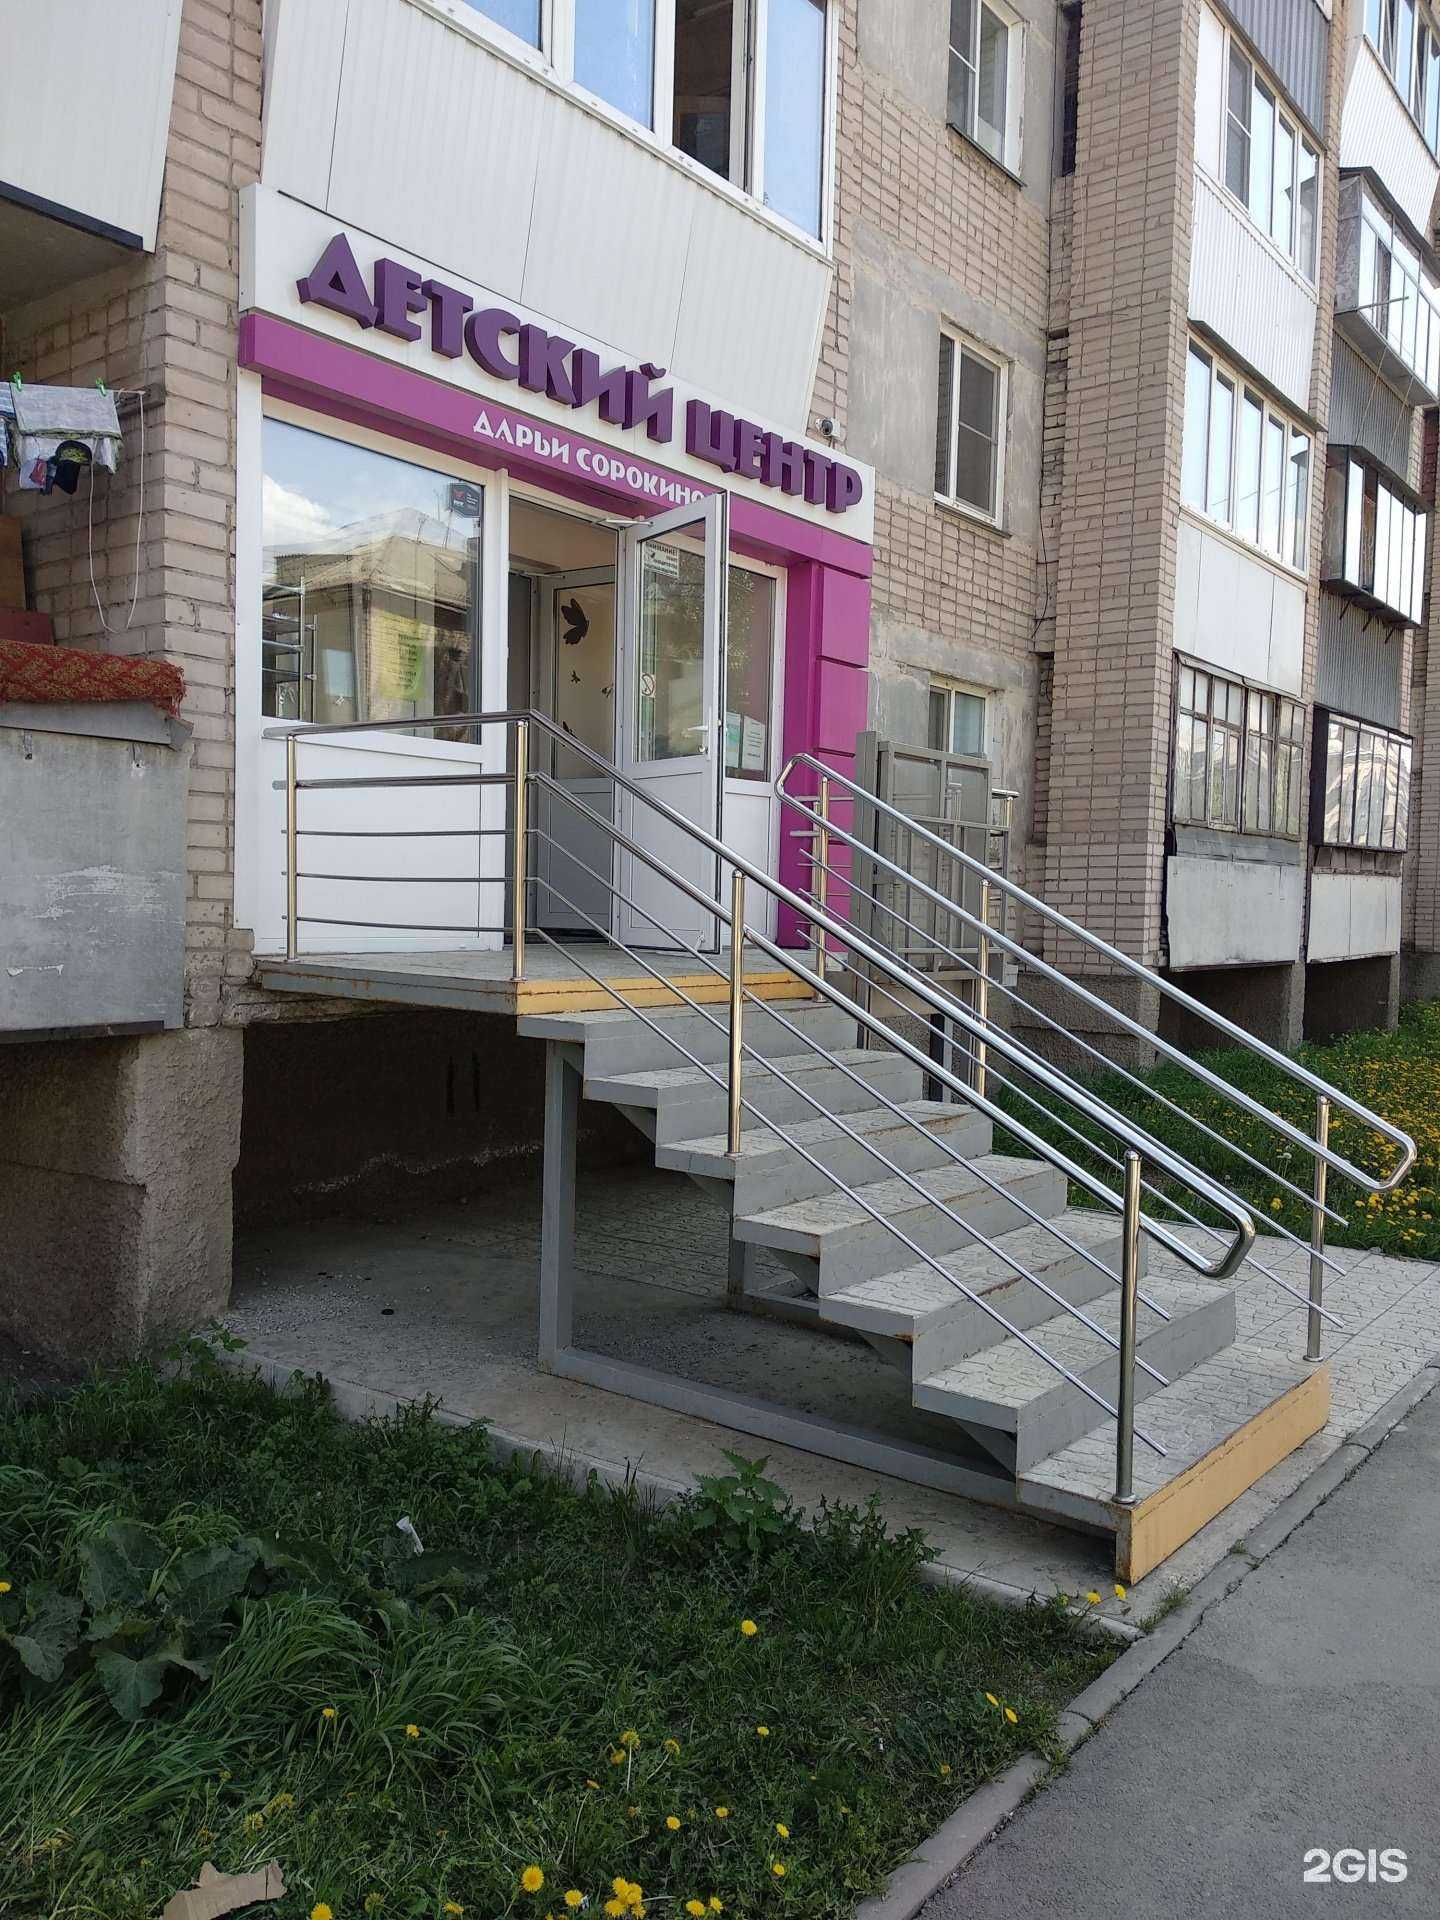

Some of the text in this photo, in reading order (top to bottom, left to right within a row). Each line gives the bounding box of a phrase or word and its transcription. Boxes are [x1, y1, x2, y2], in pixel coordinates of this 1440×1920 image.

[297, 232, 864, 513] ДЕТСКИЙ ЦЕНТР
[473, 410, 570, 464] ДАРЬИ
